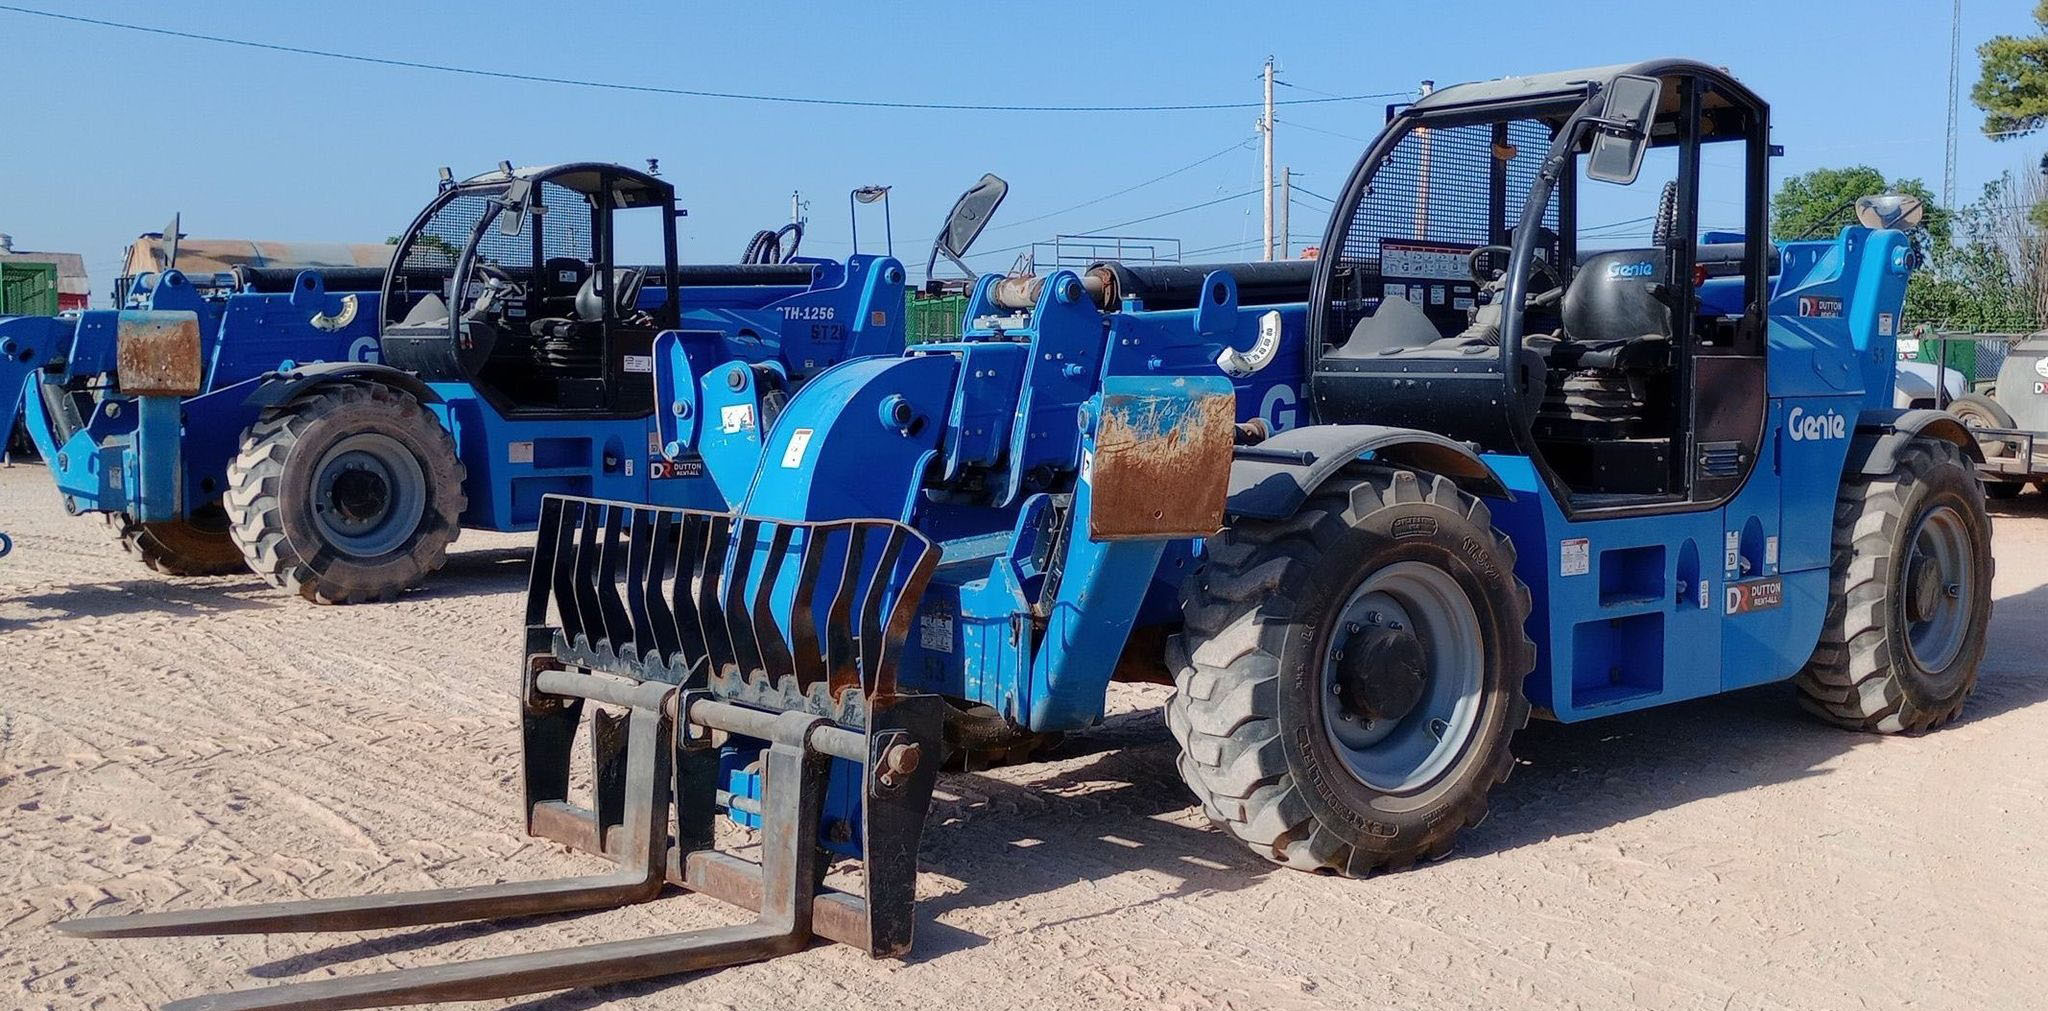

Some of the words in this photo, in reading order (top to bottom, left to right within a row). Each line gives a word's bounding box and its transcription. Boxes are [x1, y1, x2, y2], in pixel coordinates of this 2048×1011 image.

[1607, 261, 1653, 277] Genie
[1818, 301, 1842, 310] DUTTON
[776, 306, 834, 320] TH-1256
[1788, 407, 1845, 442] Genie
[673, 463, 702, 471] DUTTON
[1751, 582, 1781, 597] DUTTON
